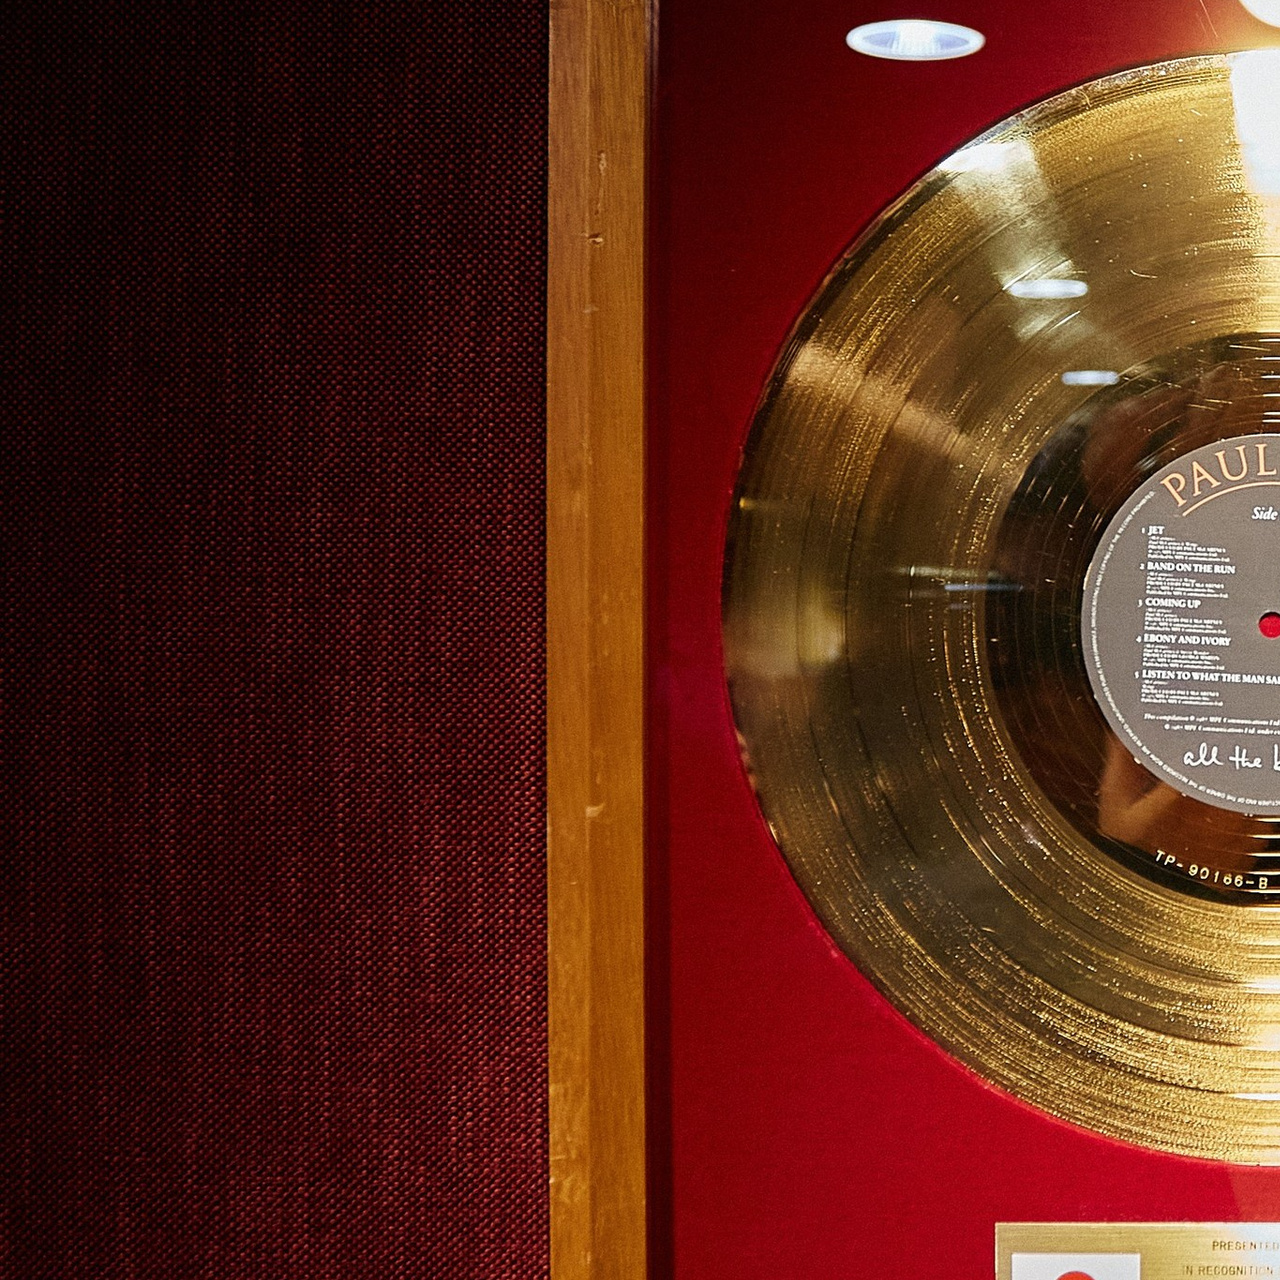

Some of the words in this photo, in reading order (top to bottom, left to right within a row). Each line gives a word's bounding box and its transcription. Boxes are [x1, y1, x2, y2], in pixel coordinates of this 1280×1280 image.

[1160, 443, 1277, 509] PAUL
[1251, 507, 1277, 521] Side
[1148, 526, 1165, 535] JET
[1147, 561, 1175, 571] BAND
[1176, 563, 1192, 572] ON
[1193, 564, 1213, 573] THE
[1214, 565, 1236, 574] RUN
[1145, 598, 1187, 608] COMING
[1187, 599, 1201, 608] UP
[1143, 633, 1177, 644] EBONY
[1178, 635, 1201, 645] AND
[1201, 636, 1232, 646] IVORY
[1142, 669, 1176, 680] LISTEN
[1176, 671, 1191, 680] TO
[1192, 672, 1221, 682] WHAT
[1222, 673, 1241, 683] THE
[1242, 674, 1265, 684] MAN
[1183, 742, 1223, 767] all
[1229, 745, 1262, 770] the
[1211, 1241, 1280, 1252] PRESENTED
[1198, 1265, 1274, 1276] RECOGNITION
